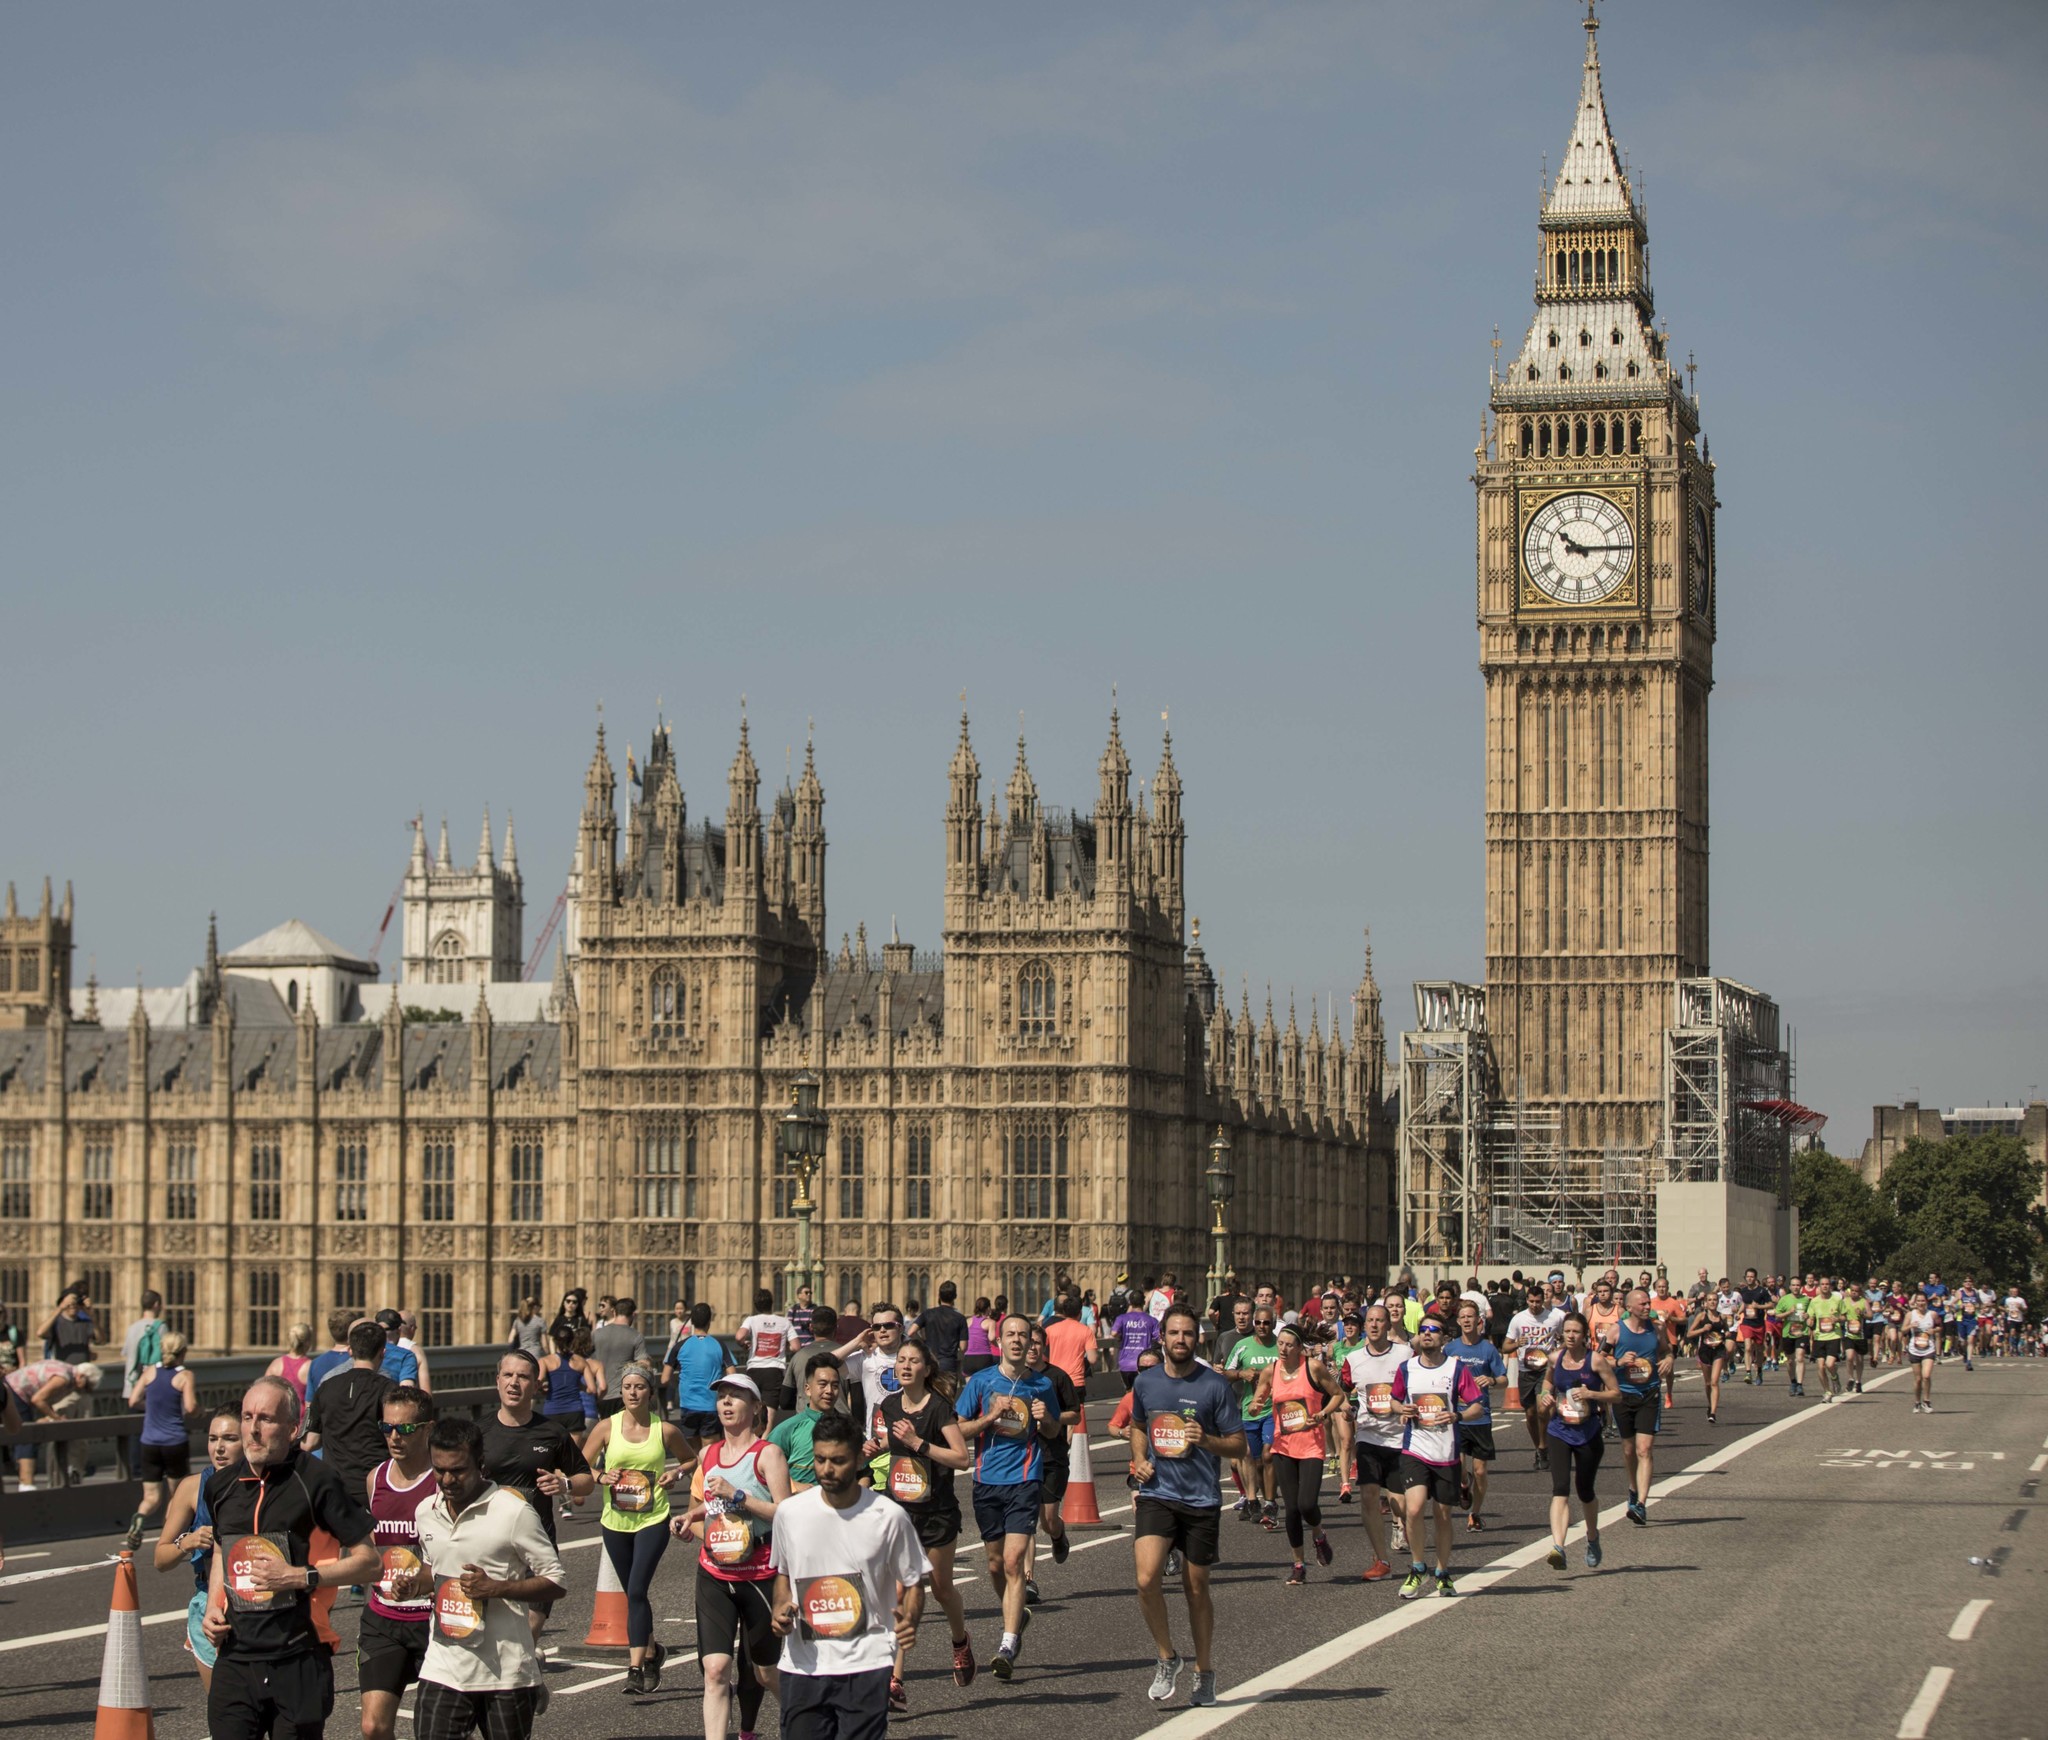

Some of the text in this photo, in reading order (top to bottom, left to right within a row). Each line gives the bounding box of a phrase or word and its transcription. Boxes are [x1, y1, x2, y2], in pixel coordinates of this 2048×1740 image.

[1418, 1405, 1445, 1413] C1103
[1814, 1448, 2005, 1460] LANE
[1819, 1459, 1975, 1470] BUS
[710, 1530, 744, 1542] C7597
[233, 1560, 257, 1575] C3
[442, 1599, 473, 1614] B525
[809, 1597, 853, 1612] C3641
